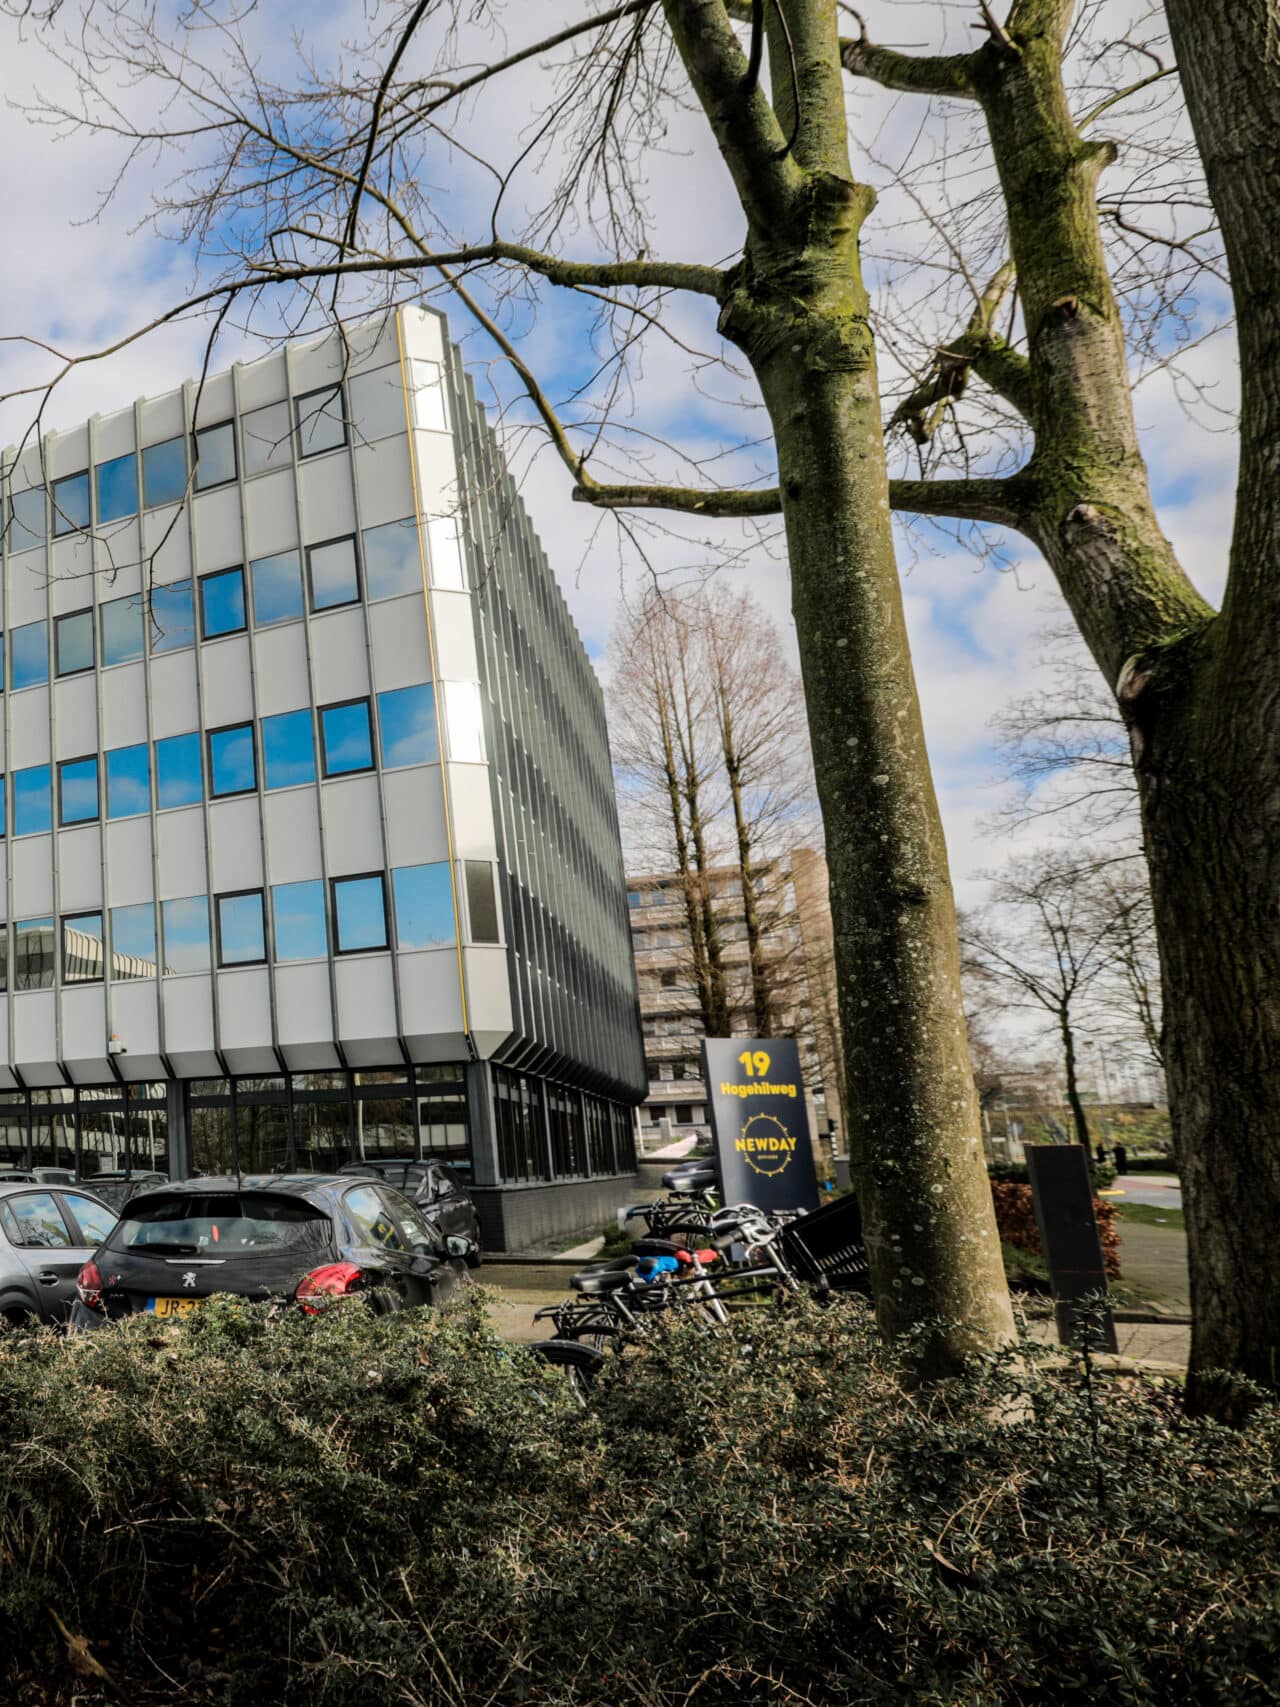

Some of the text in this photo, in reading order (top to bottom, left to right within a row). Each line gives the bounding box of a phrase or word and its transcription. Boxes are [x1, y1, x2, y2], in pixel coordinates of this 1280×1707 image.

[738, 1050, 771, 1077] 19
[720, 1082, 798, 1099] Hogehilweg
[735, 1137, 797, 1152] NEWDAY
